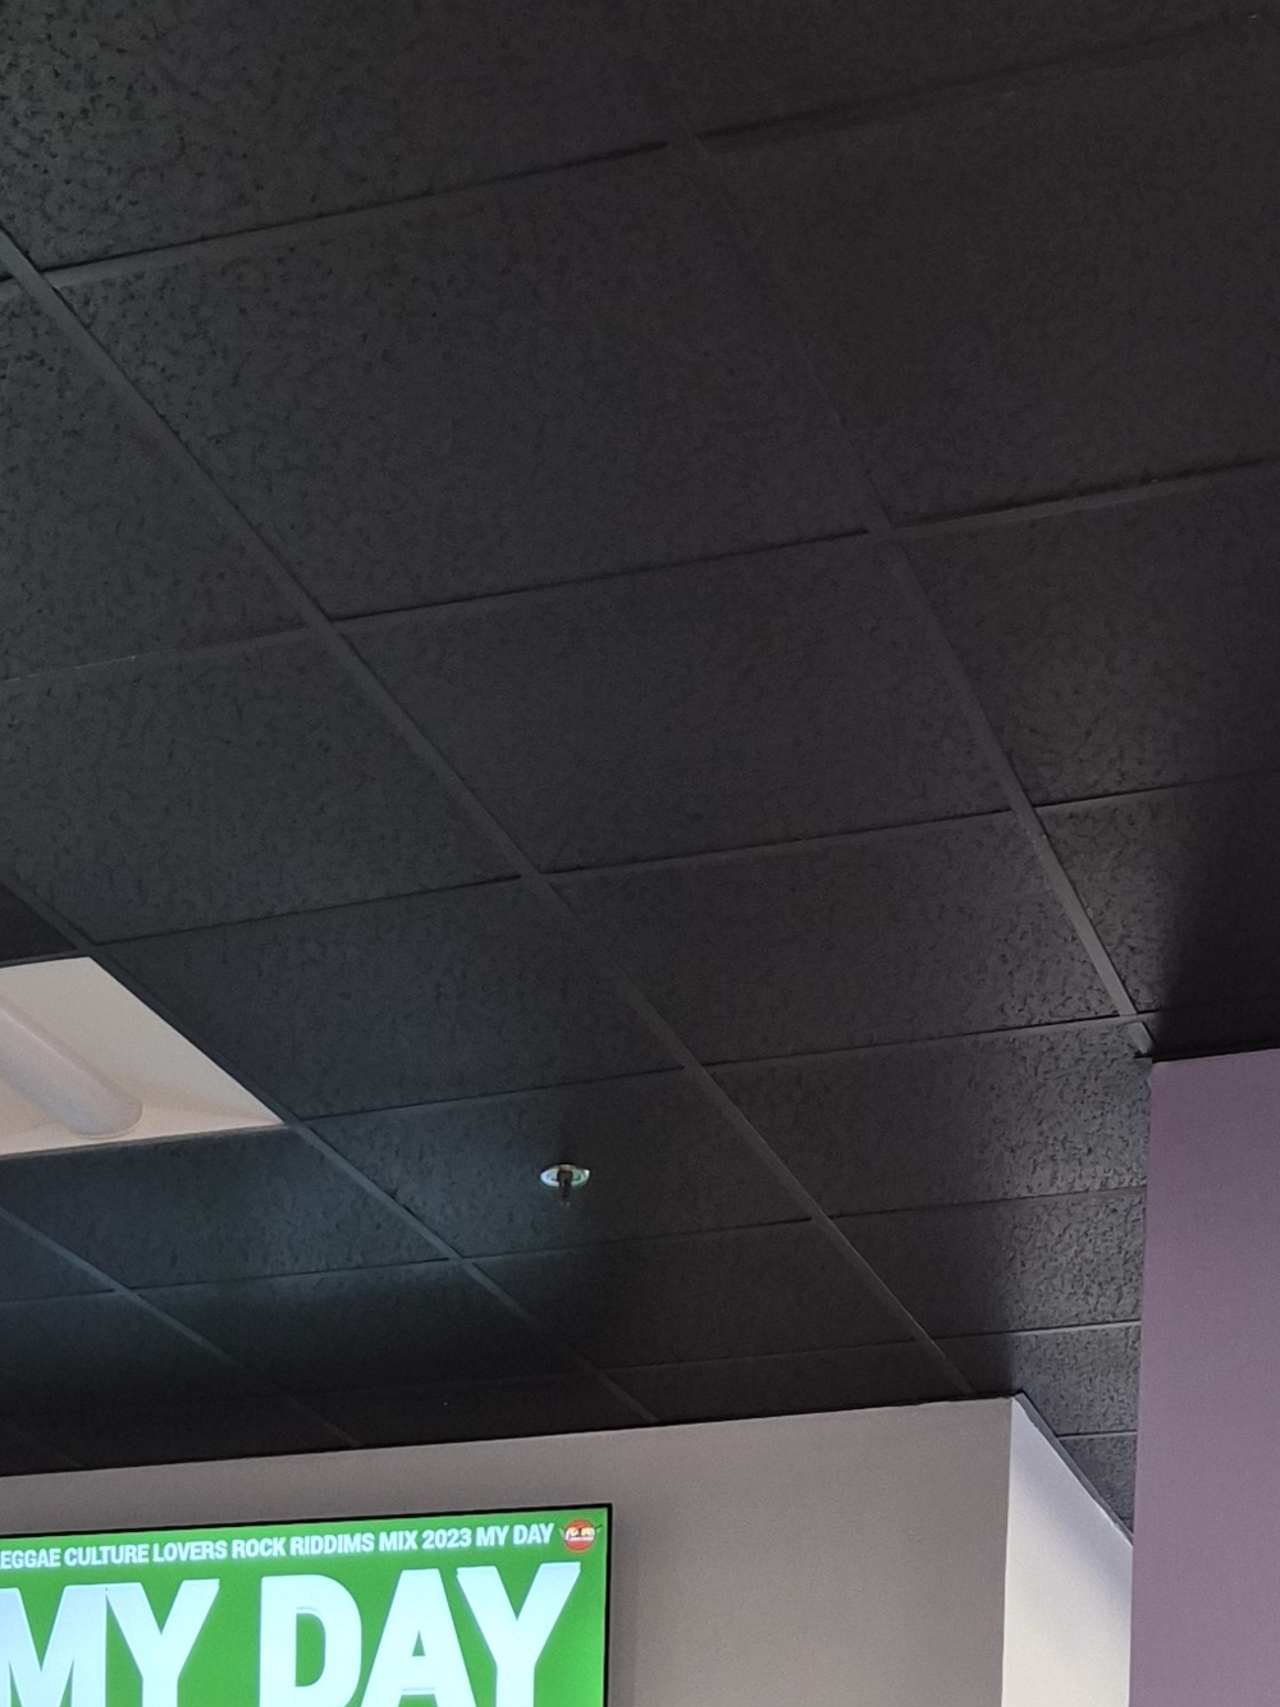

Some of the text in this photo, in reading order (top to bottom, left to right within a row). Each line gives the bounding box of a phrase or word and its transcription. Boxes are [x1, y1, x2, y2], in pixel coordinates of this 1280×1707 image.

[64, 1543, 149, 1566] CULTURE
[153, 1540, 226, 1562] LOVERS
[232, 1537, 286, 1558] ROCK
[290, 1532, 375, 1556] RIDDIMS
[379, 1530, 418, 1552] MIX
[422, 1527, 472, 1549] 2023
[476, 1525, 509, 1547] MY
[513, 1523, 554, 1544] DAY
